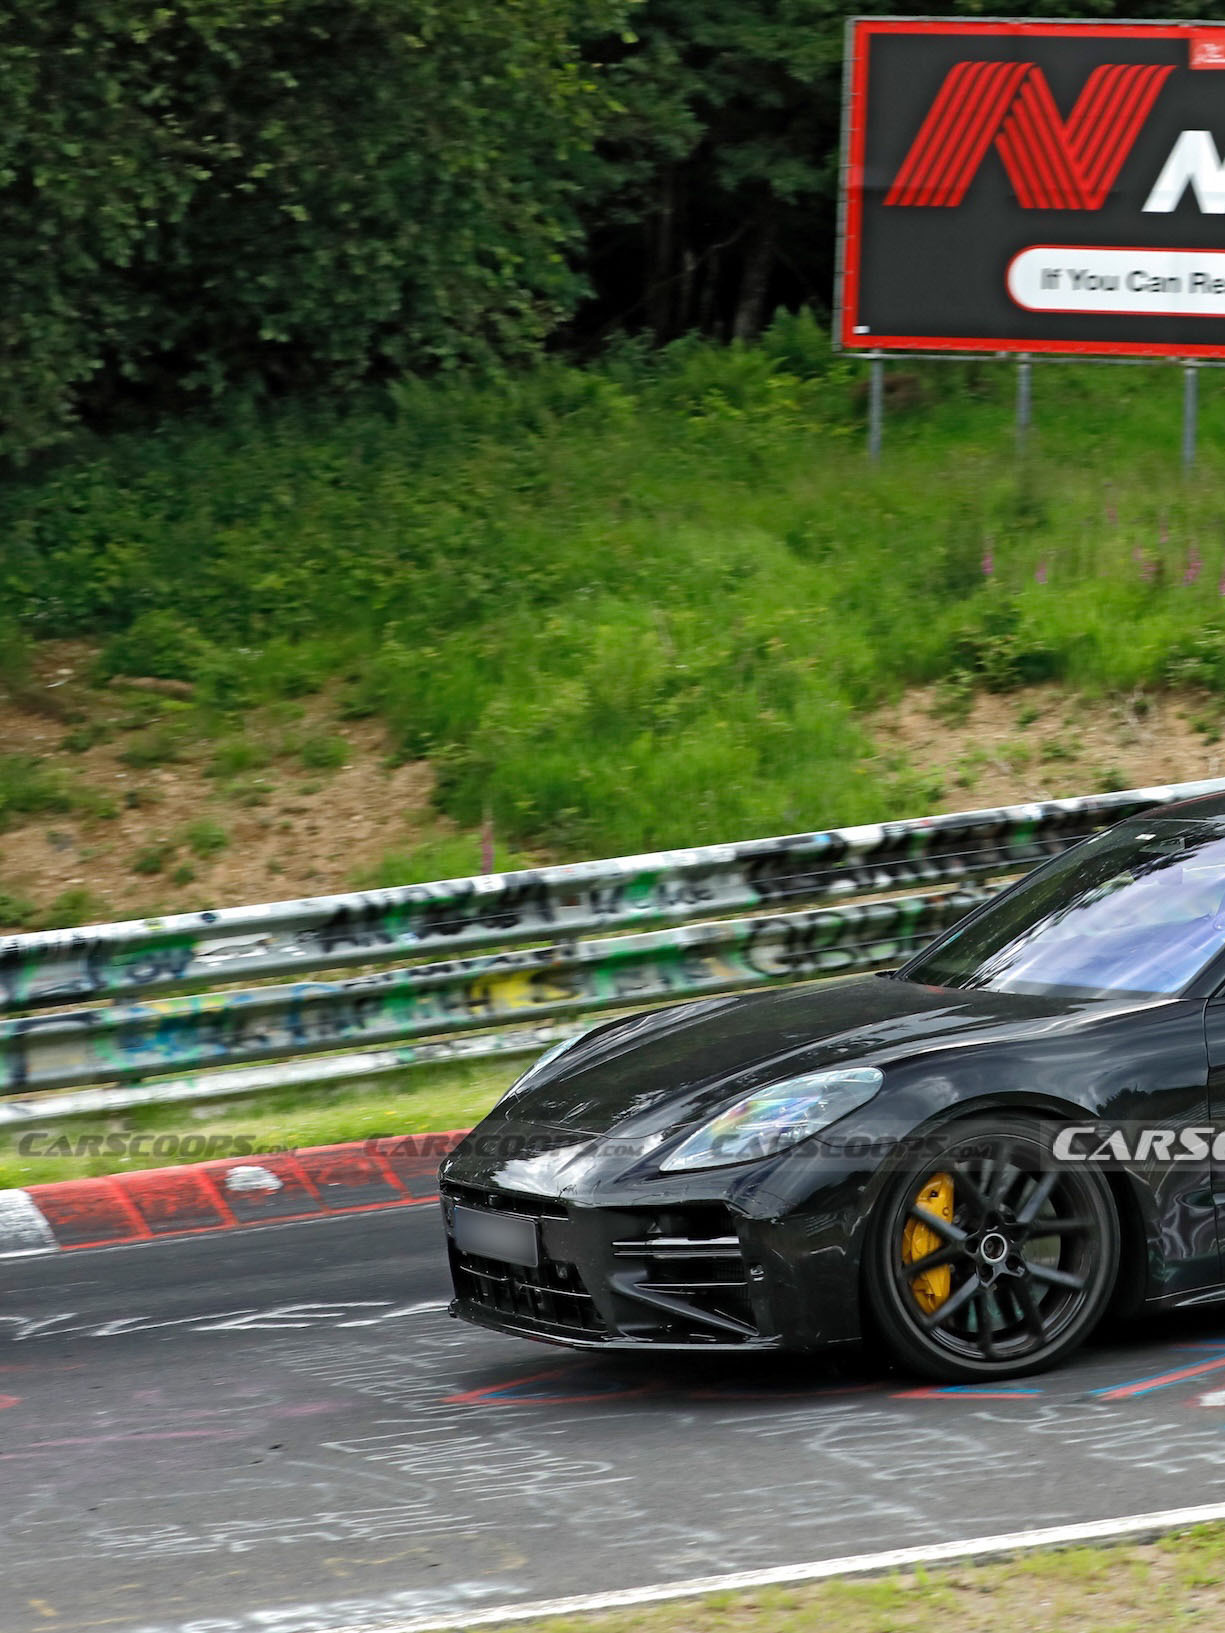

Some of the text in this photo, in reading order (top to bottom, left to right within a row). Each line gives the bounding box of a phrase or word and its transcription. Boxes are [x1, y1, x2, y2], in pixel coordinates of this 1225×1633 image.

[1039, 268, 1062, 290] If
[1067, 268, 1120, 291] You
[1125, 270, 1183, 293] Can
